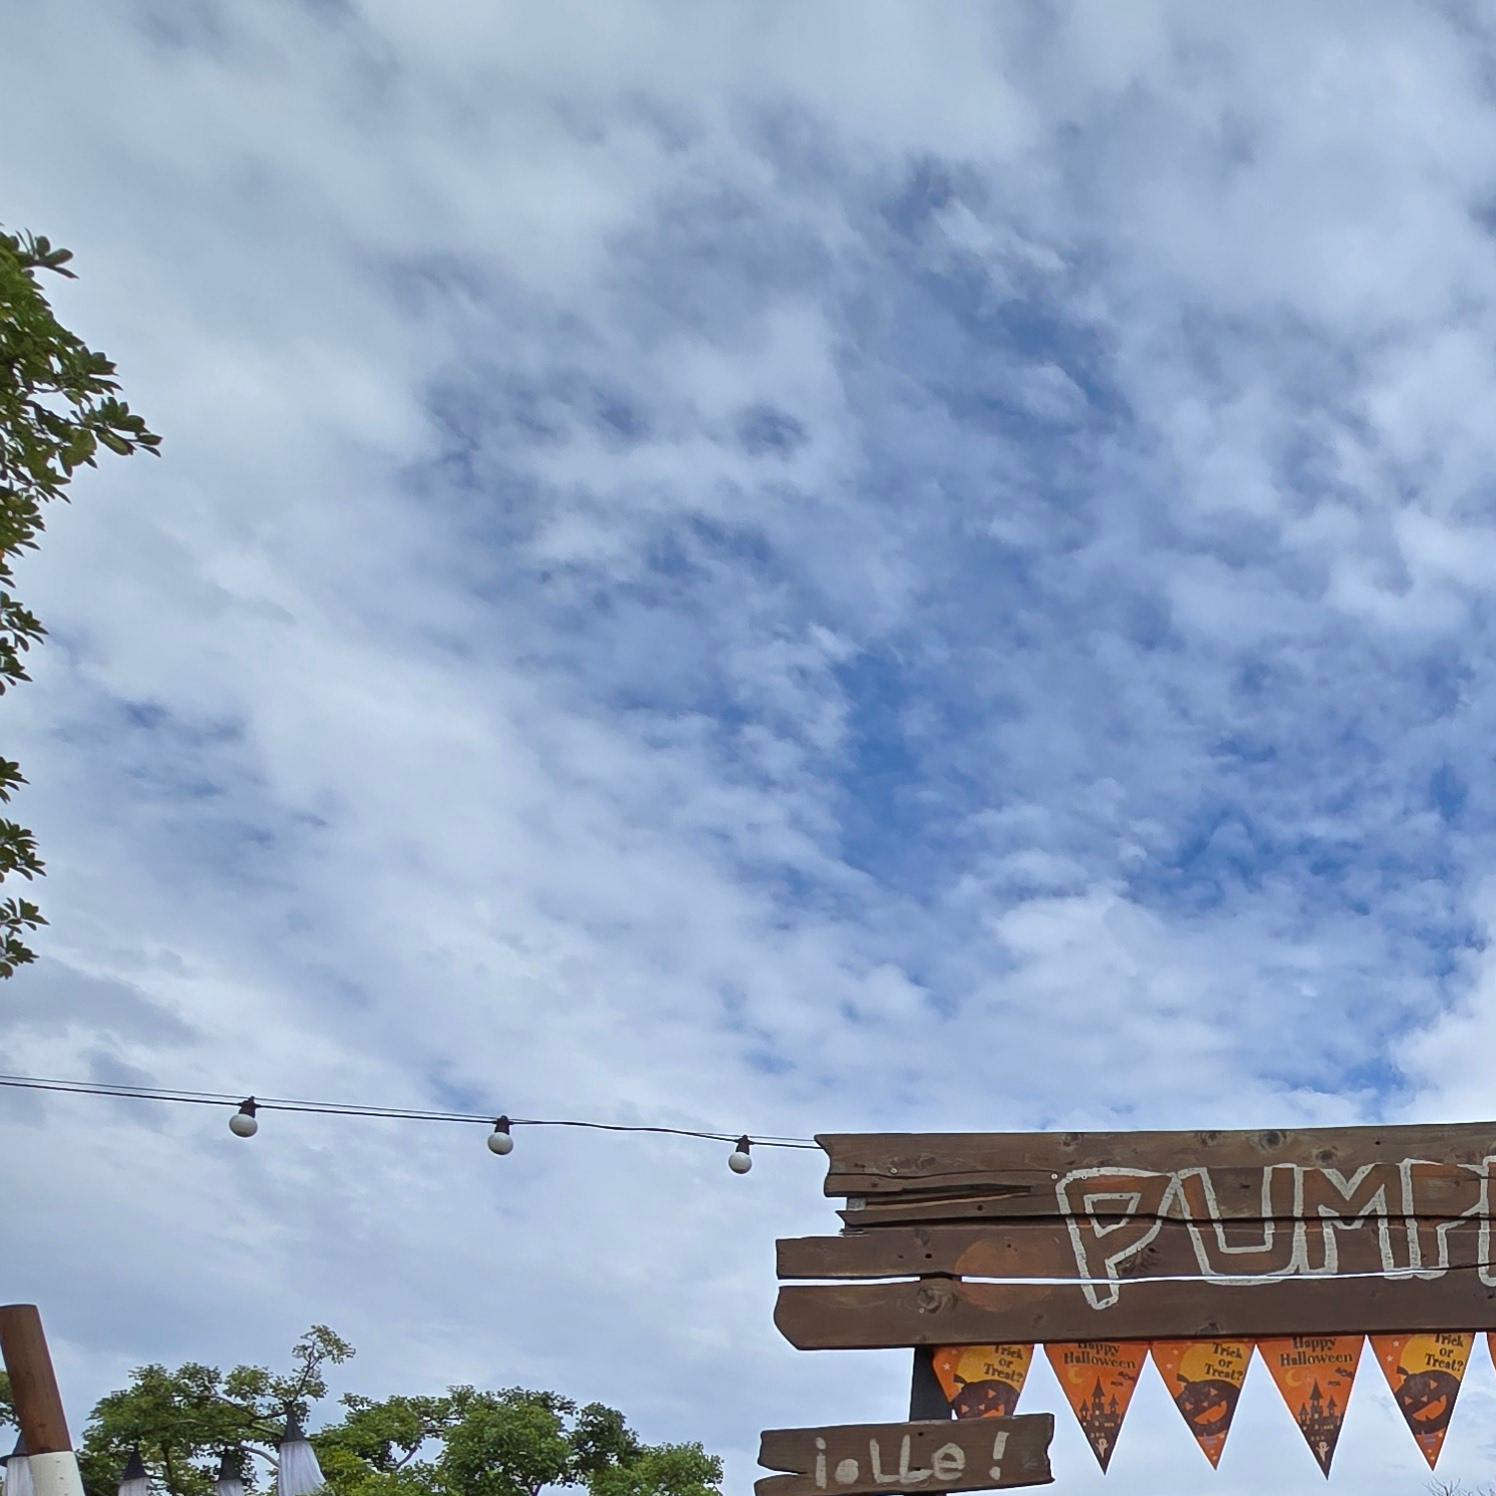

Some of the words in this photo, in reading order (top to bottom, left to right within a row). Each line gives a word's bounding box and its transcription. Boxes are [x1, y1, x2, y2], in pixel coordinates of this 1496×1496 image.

[1292, 1336, 1337, 1352] Happy
[1434, 1332, 1464, 1347] Trick
[994, 1344, 1023, 1360] Trick
[1212, 1342, 1242, 1359] Trick
[1439, 1347, 1454, 1358] or
[999, 1358, 1014, 1369] or
[1064, 1351, 1136, 1369] Halloween
[1218, 1359, 1233, 1368] or
[1280, 1351, 1353, 1367] Halloween
[1425, 1352, 1464, 1372] Treat?
[984, 1362, 1024, 1382] Treat?
[1205, 1362, 1244, 1381] Treat?
